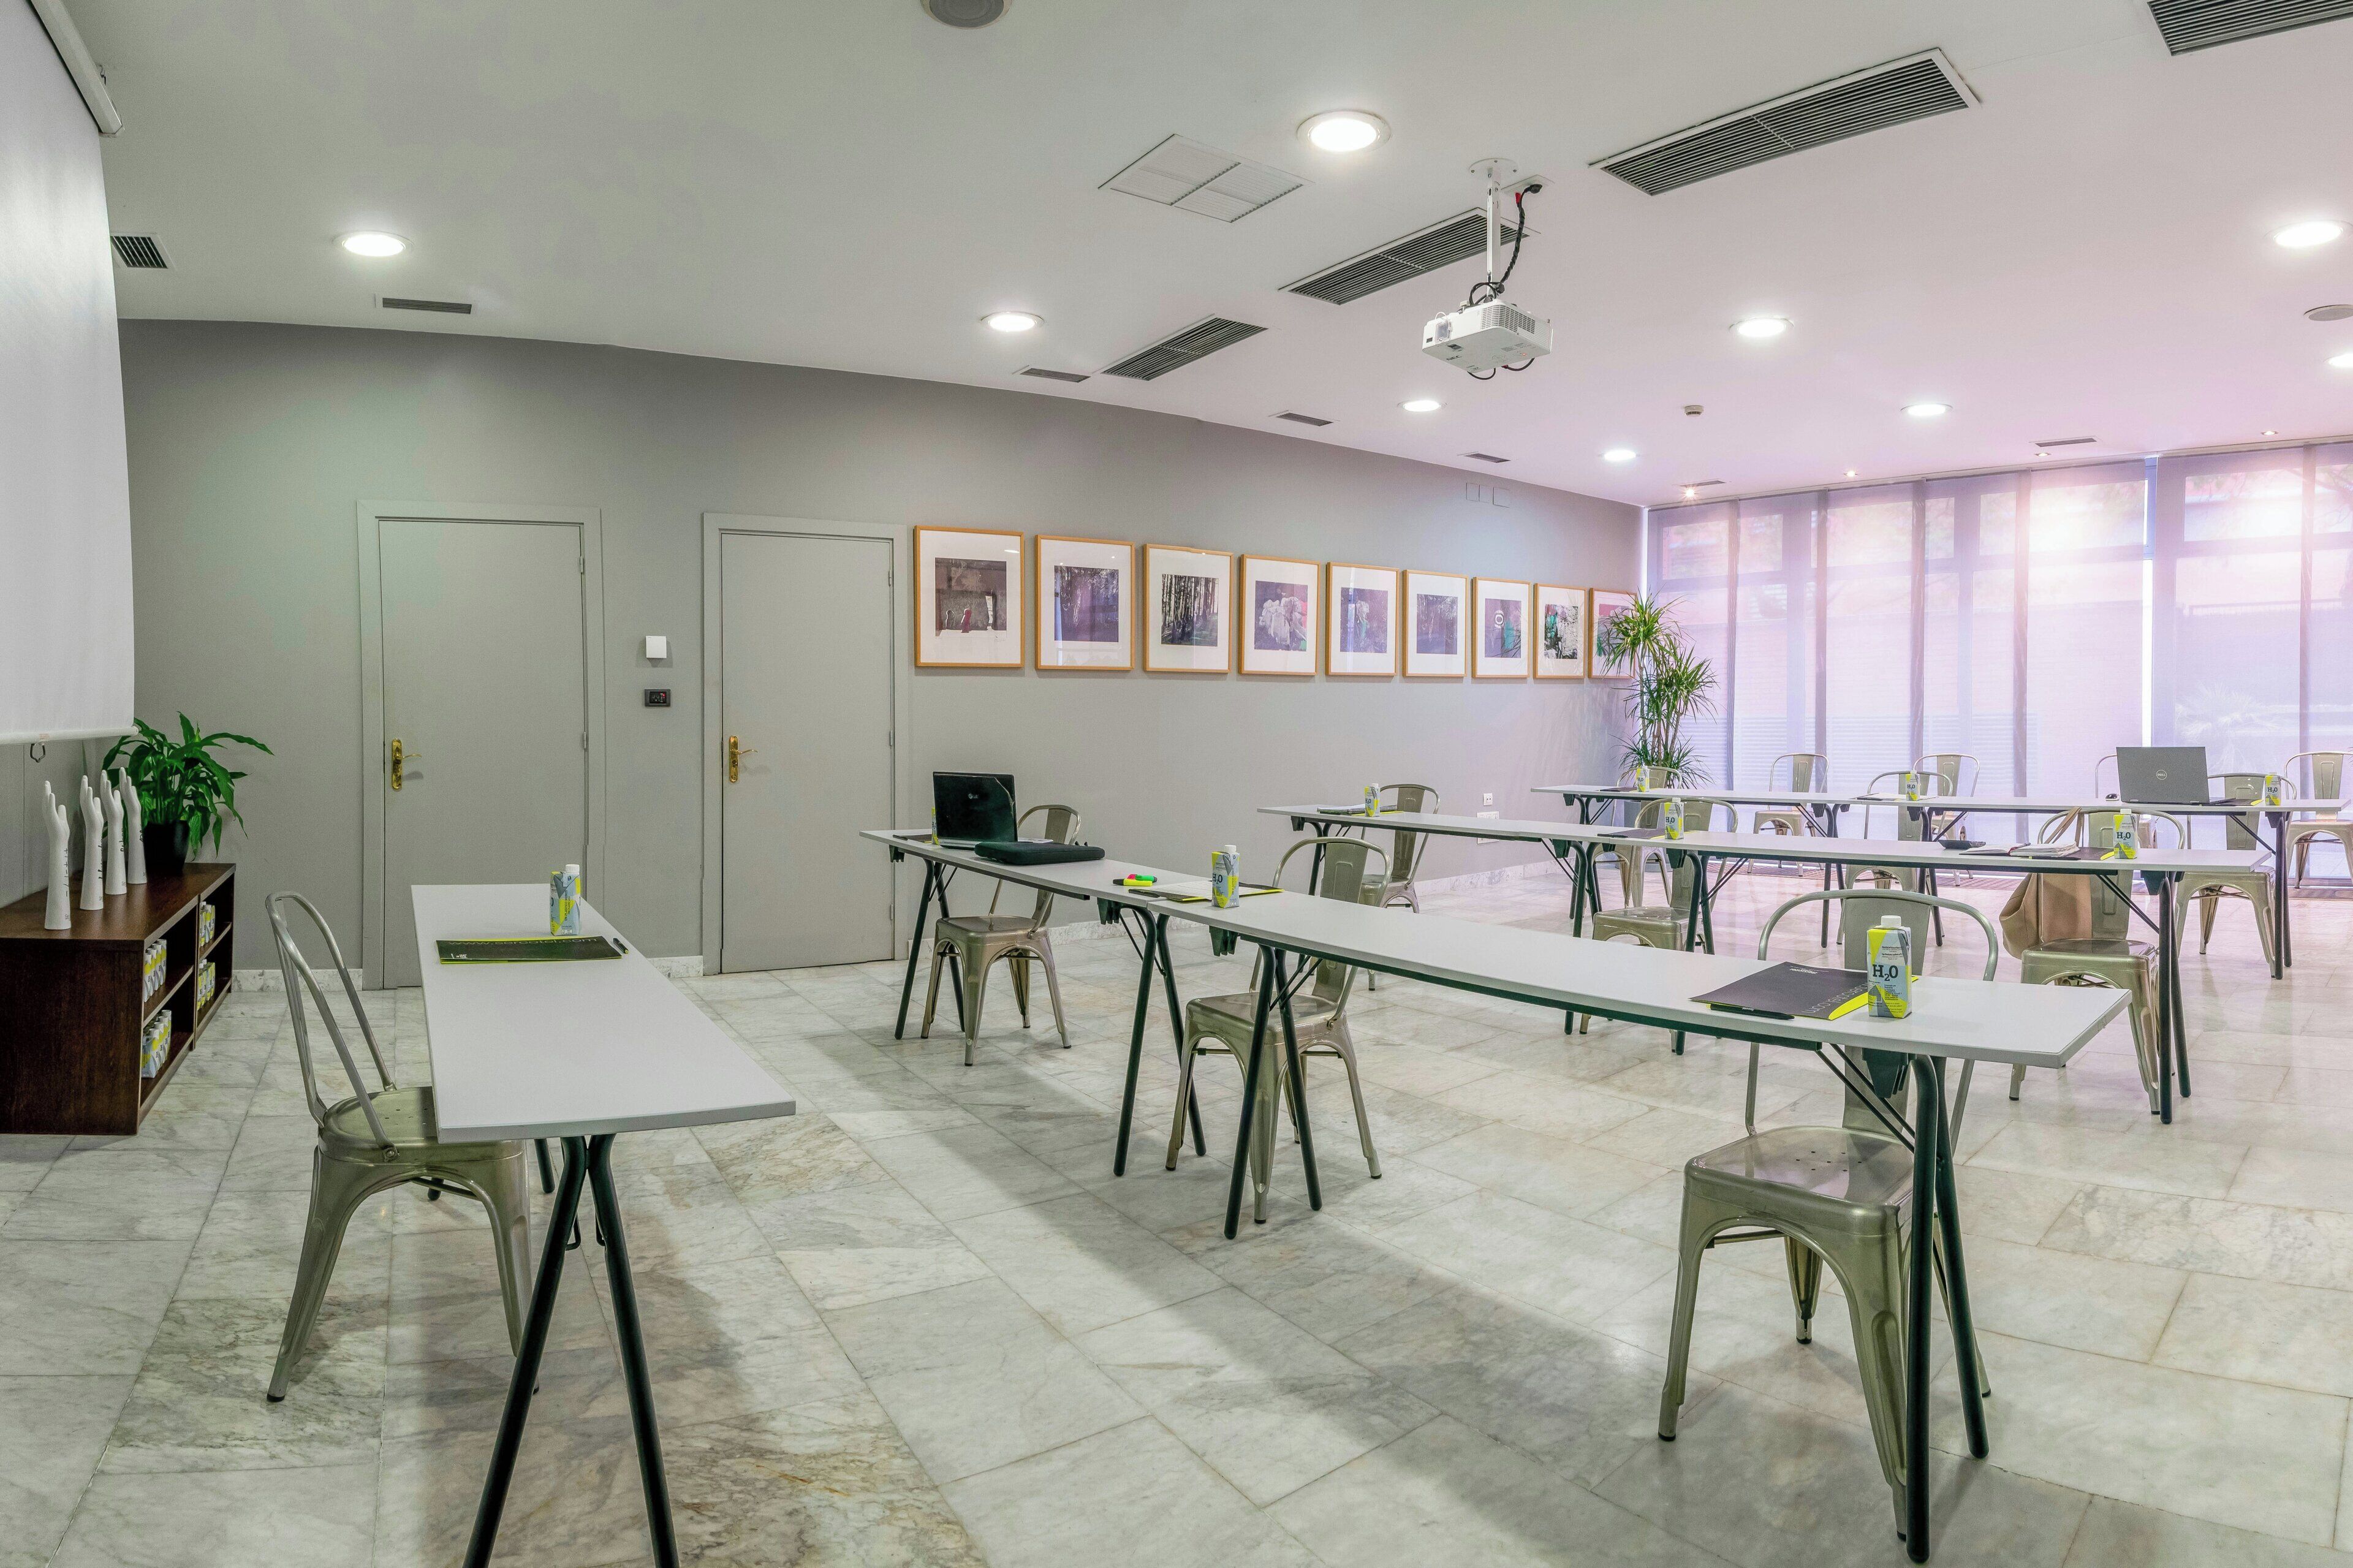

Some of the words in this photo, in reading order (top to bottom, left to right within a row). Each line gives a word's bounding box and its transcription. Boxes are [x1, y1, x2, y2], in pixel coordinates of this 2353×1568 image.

[2116, 831, 2131, 841] H2O
[1212, 873, 1223, 885] H2O
[1872, 964, 1899, 982] H2O
